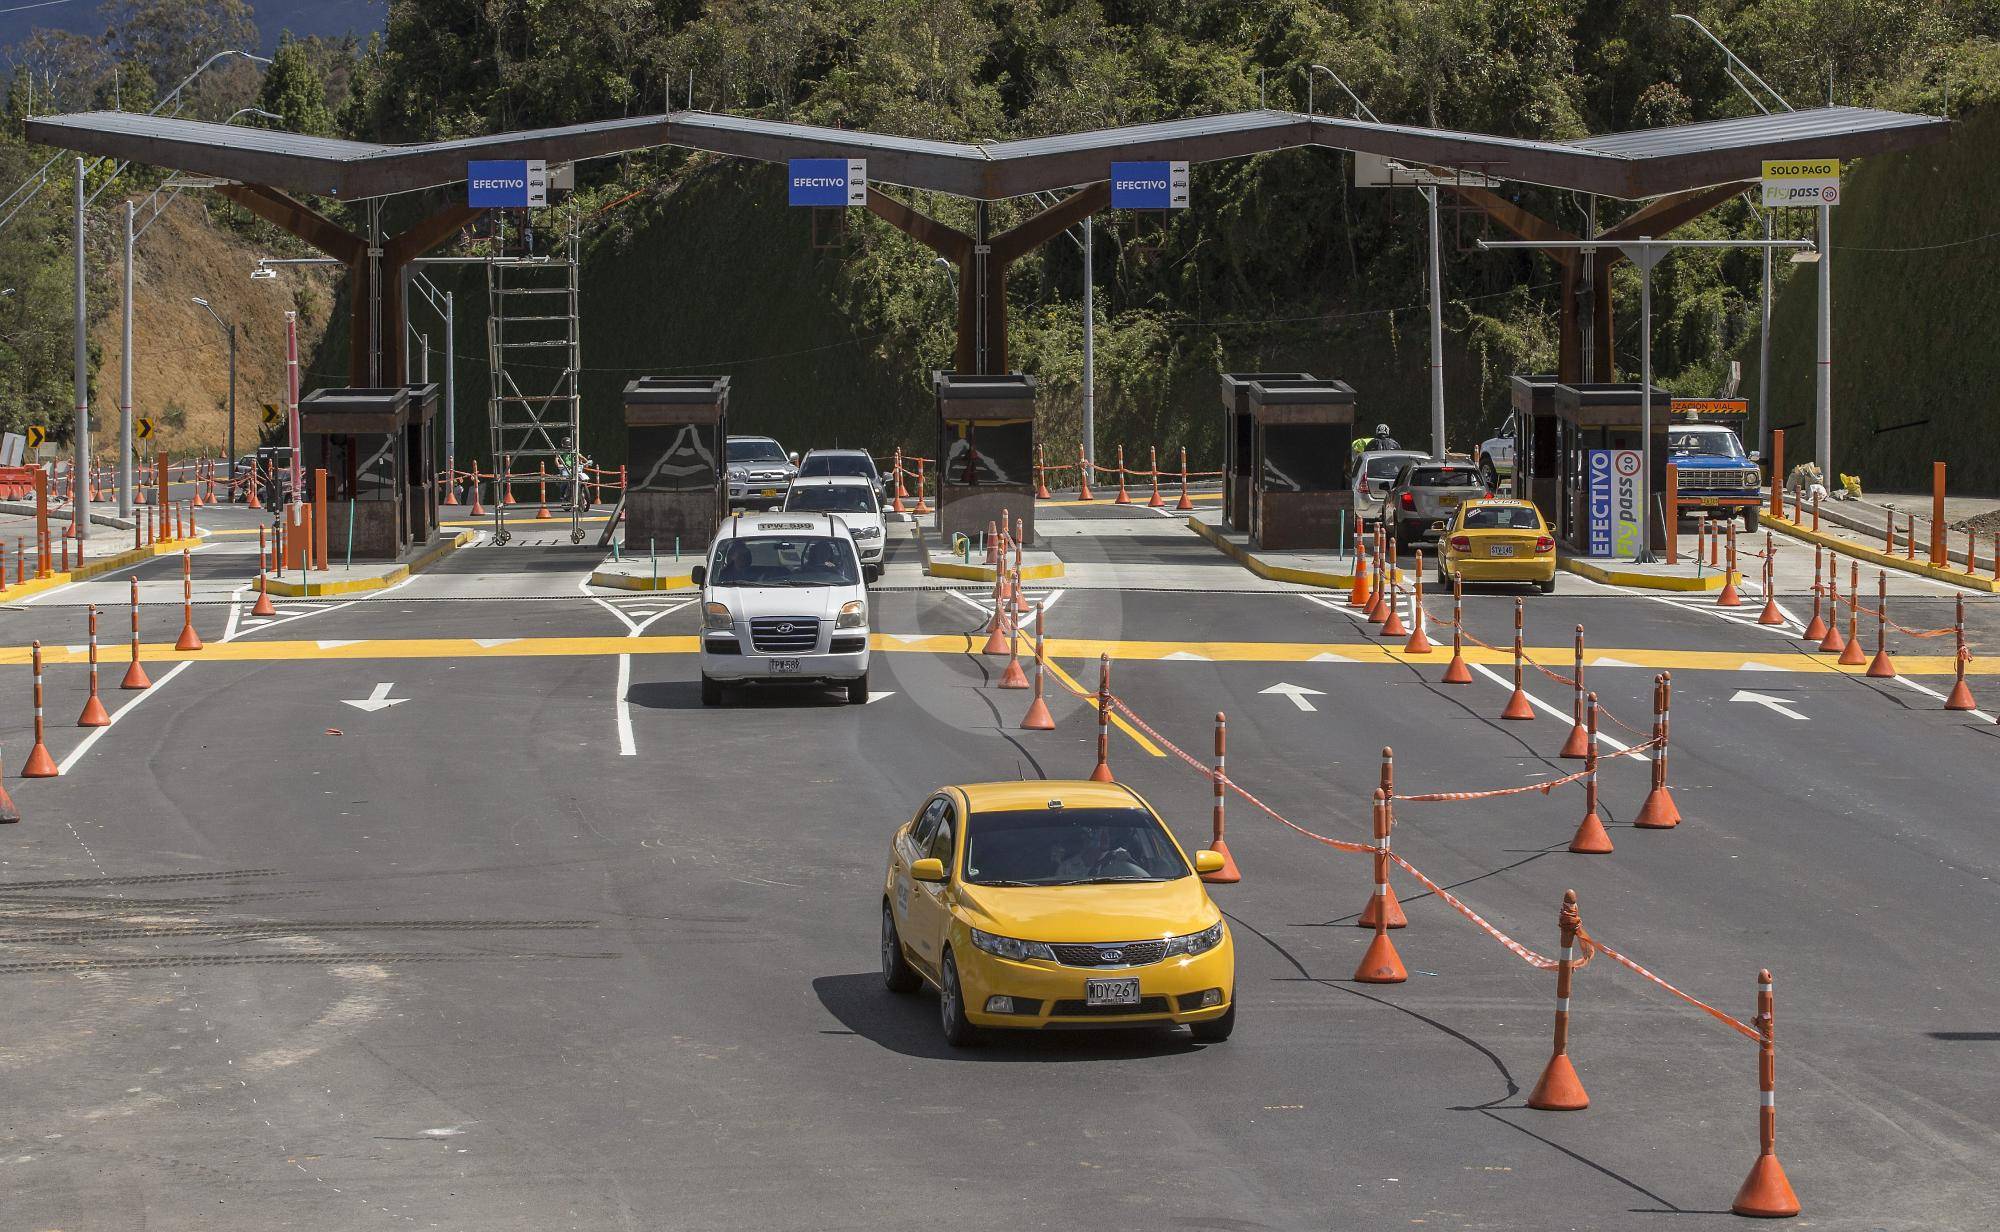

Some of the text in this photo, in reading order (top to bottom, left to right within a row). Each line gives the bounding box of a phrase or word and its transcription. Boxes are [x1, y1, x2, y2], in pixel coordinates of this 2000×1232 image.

[1771, 165, 1831, 175] SOLO PAGO
[473, 179, 524, 189] EFECTIVO
[793, 178, 845, 187] EFECTIVO
[1116, 180, 1167, 190] EFECTIVO
[1713, 402, 1733, 410] VIAL
[1624, 456, 1634, 471] 20
[1591, 453, 1609, 555] EFECTIVO
[1617, 477, 1638, 557] Flypass
